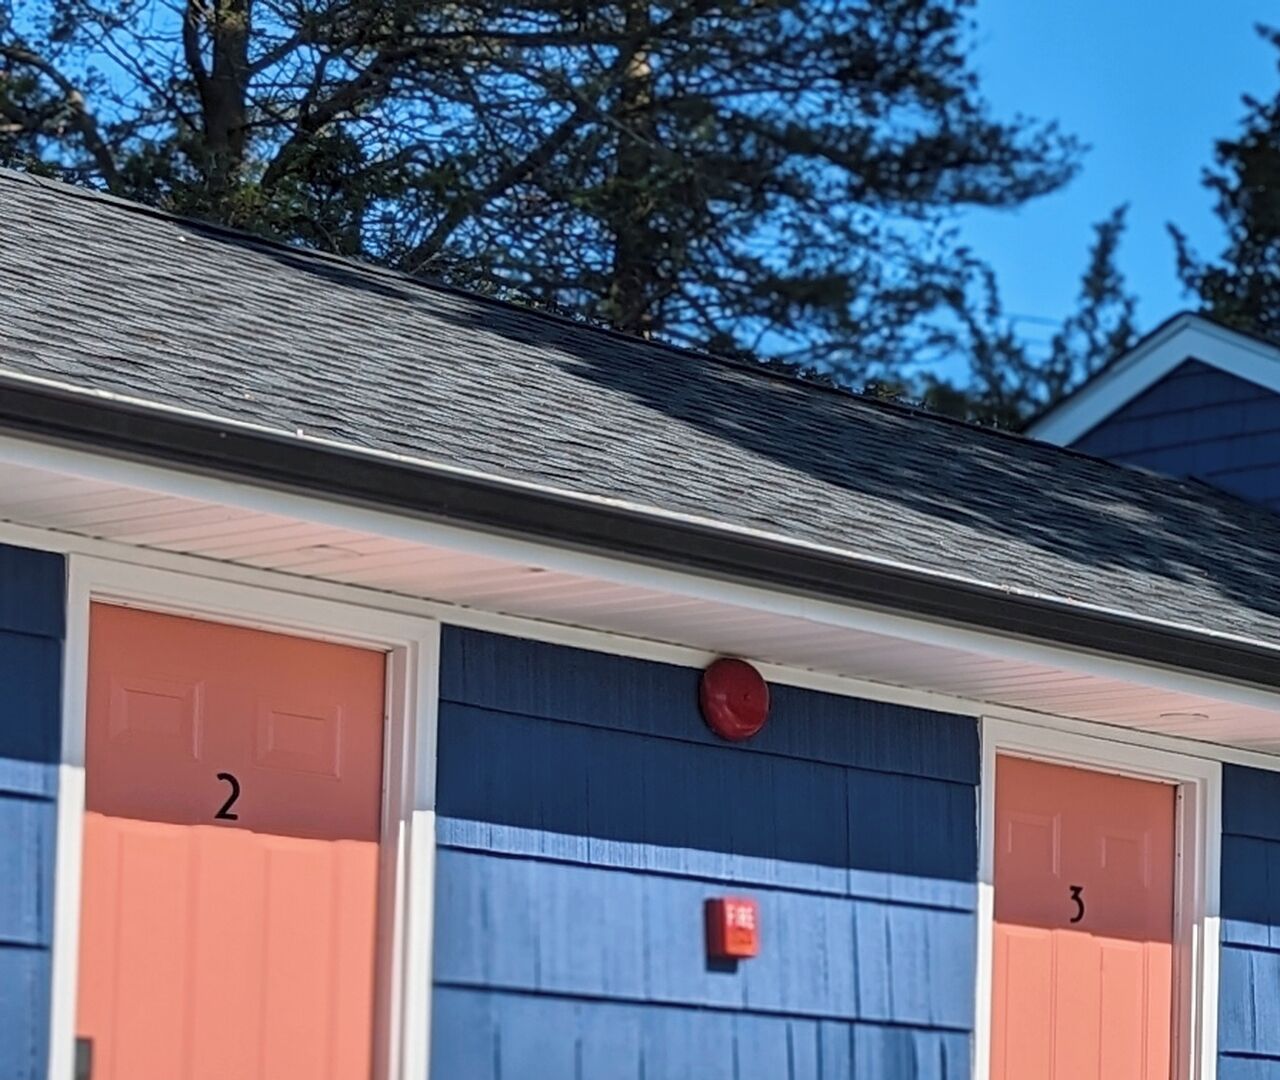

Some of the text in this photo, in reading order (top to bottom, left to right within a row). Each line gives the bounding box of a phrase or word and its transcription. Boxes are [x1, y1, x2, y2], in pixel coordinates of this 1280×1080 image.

[214, 773, 240, 820] 2
[725, 904, 755, 930] FIRE
[1069, 886, 1085, 923] 3
